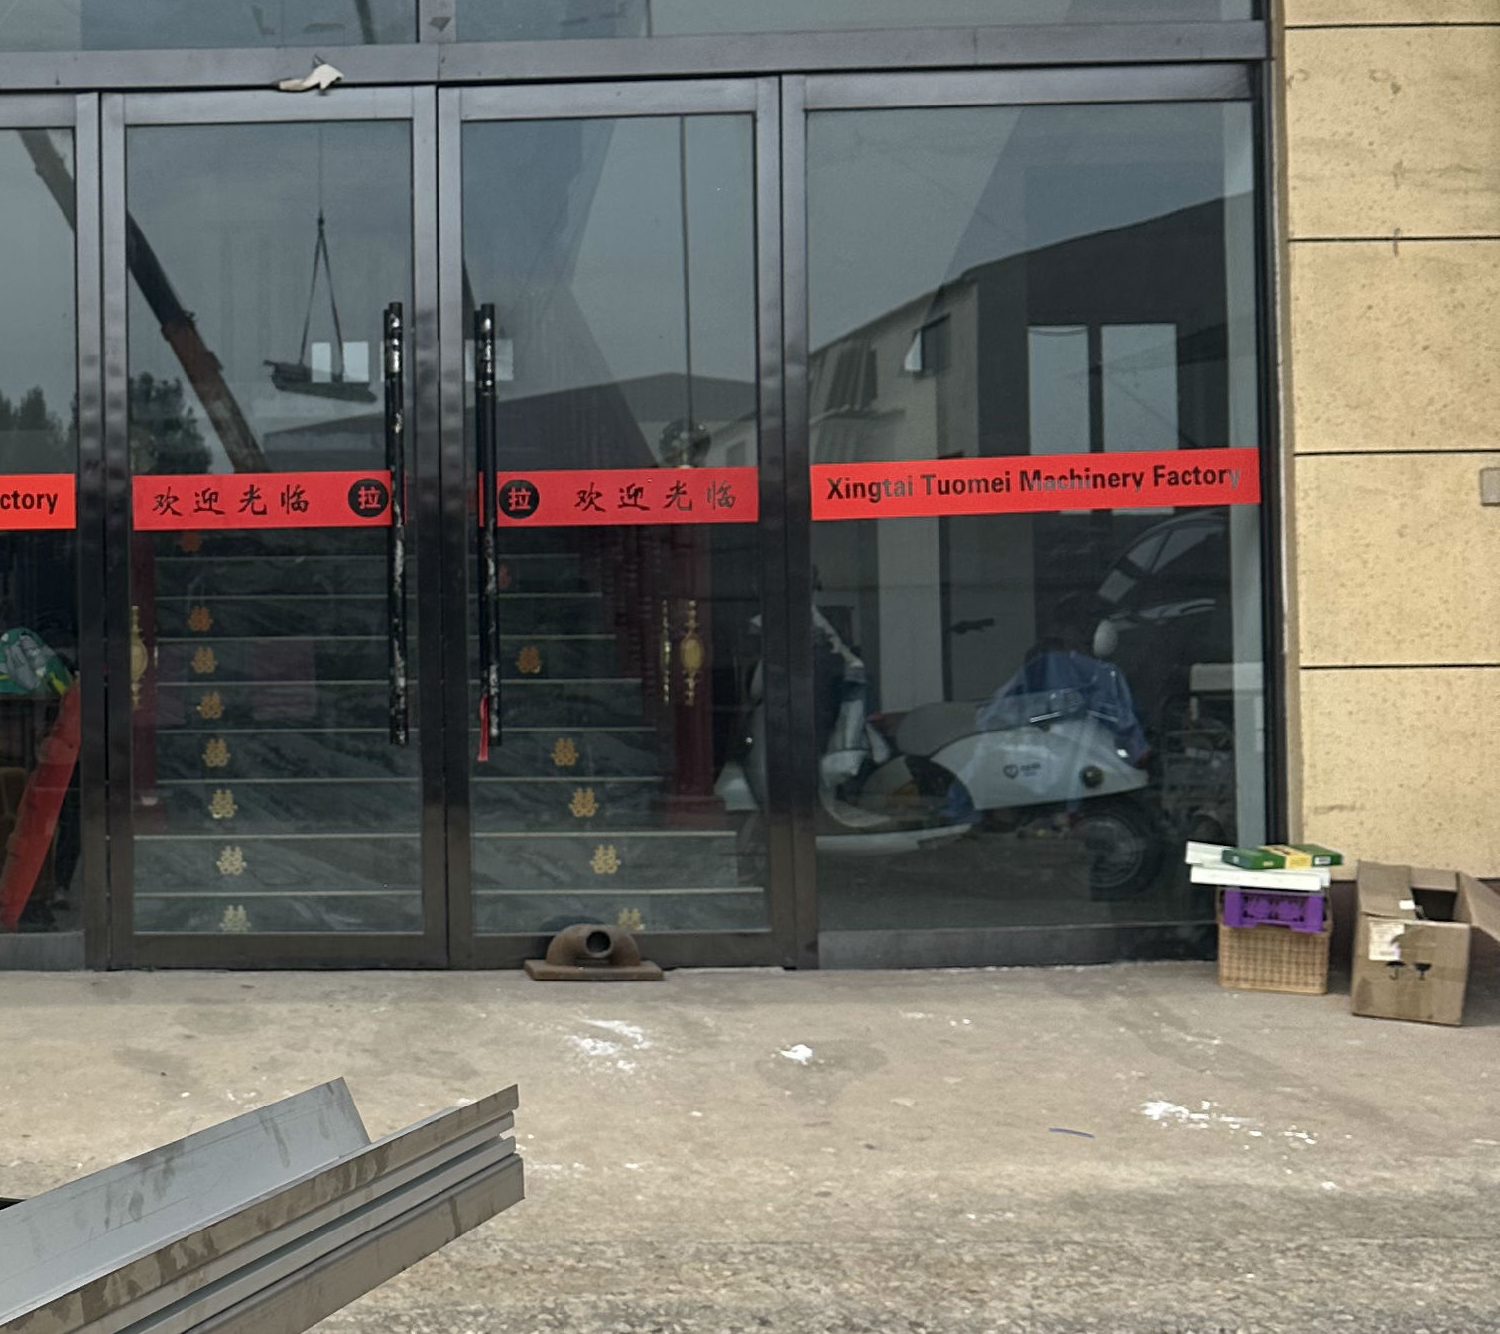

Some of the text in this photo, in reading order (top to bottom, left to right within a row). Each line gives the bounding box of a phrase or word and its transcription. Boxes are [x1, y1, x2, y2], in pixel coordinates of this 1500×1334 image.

[152, 483, 310, 517] 欢迎光临
[358, 485, 382, 510] 拉
[508, 487, 532, 512] 拉
[574, 479, 737, 513] 欢迎光临
[827, 464, 1242, 503] Xingtai Tuomei Machinery Factory
